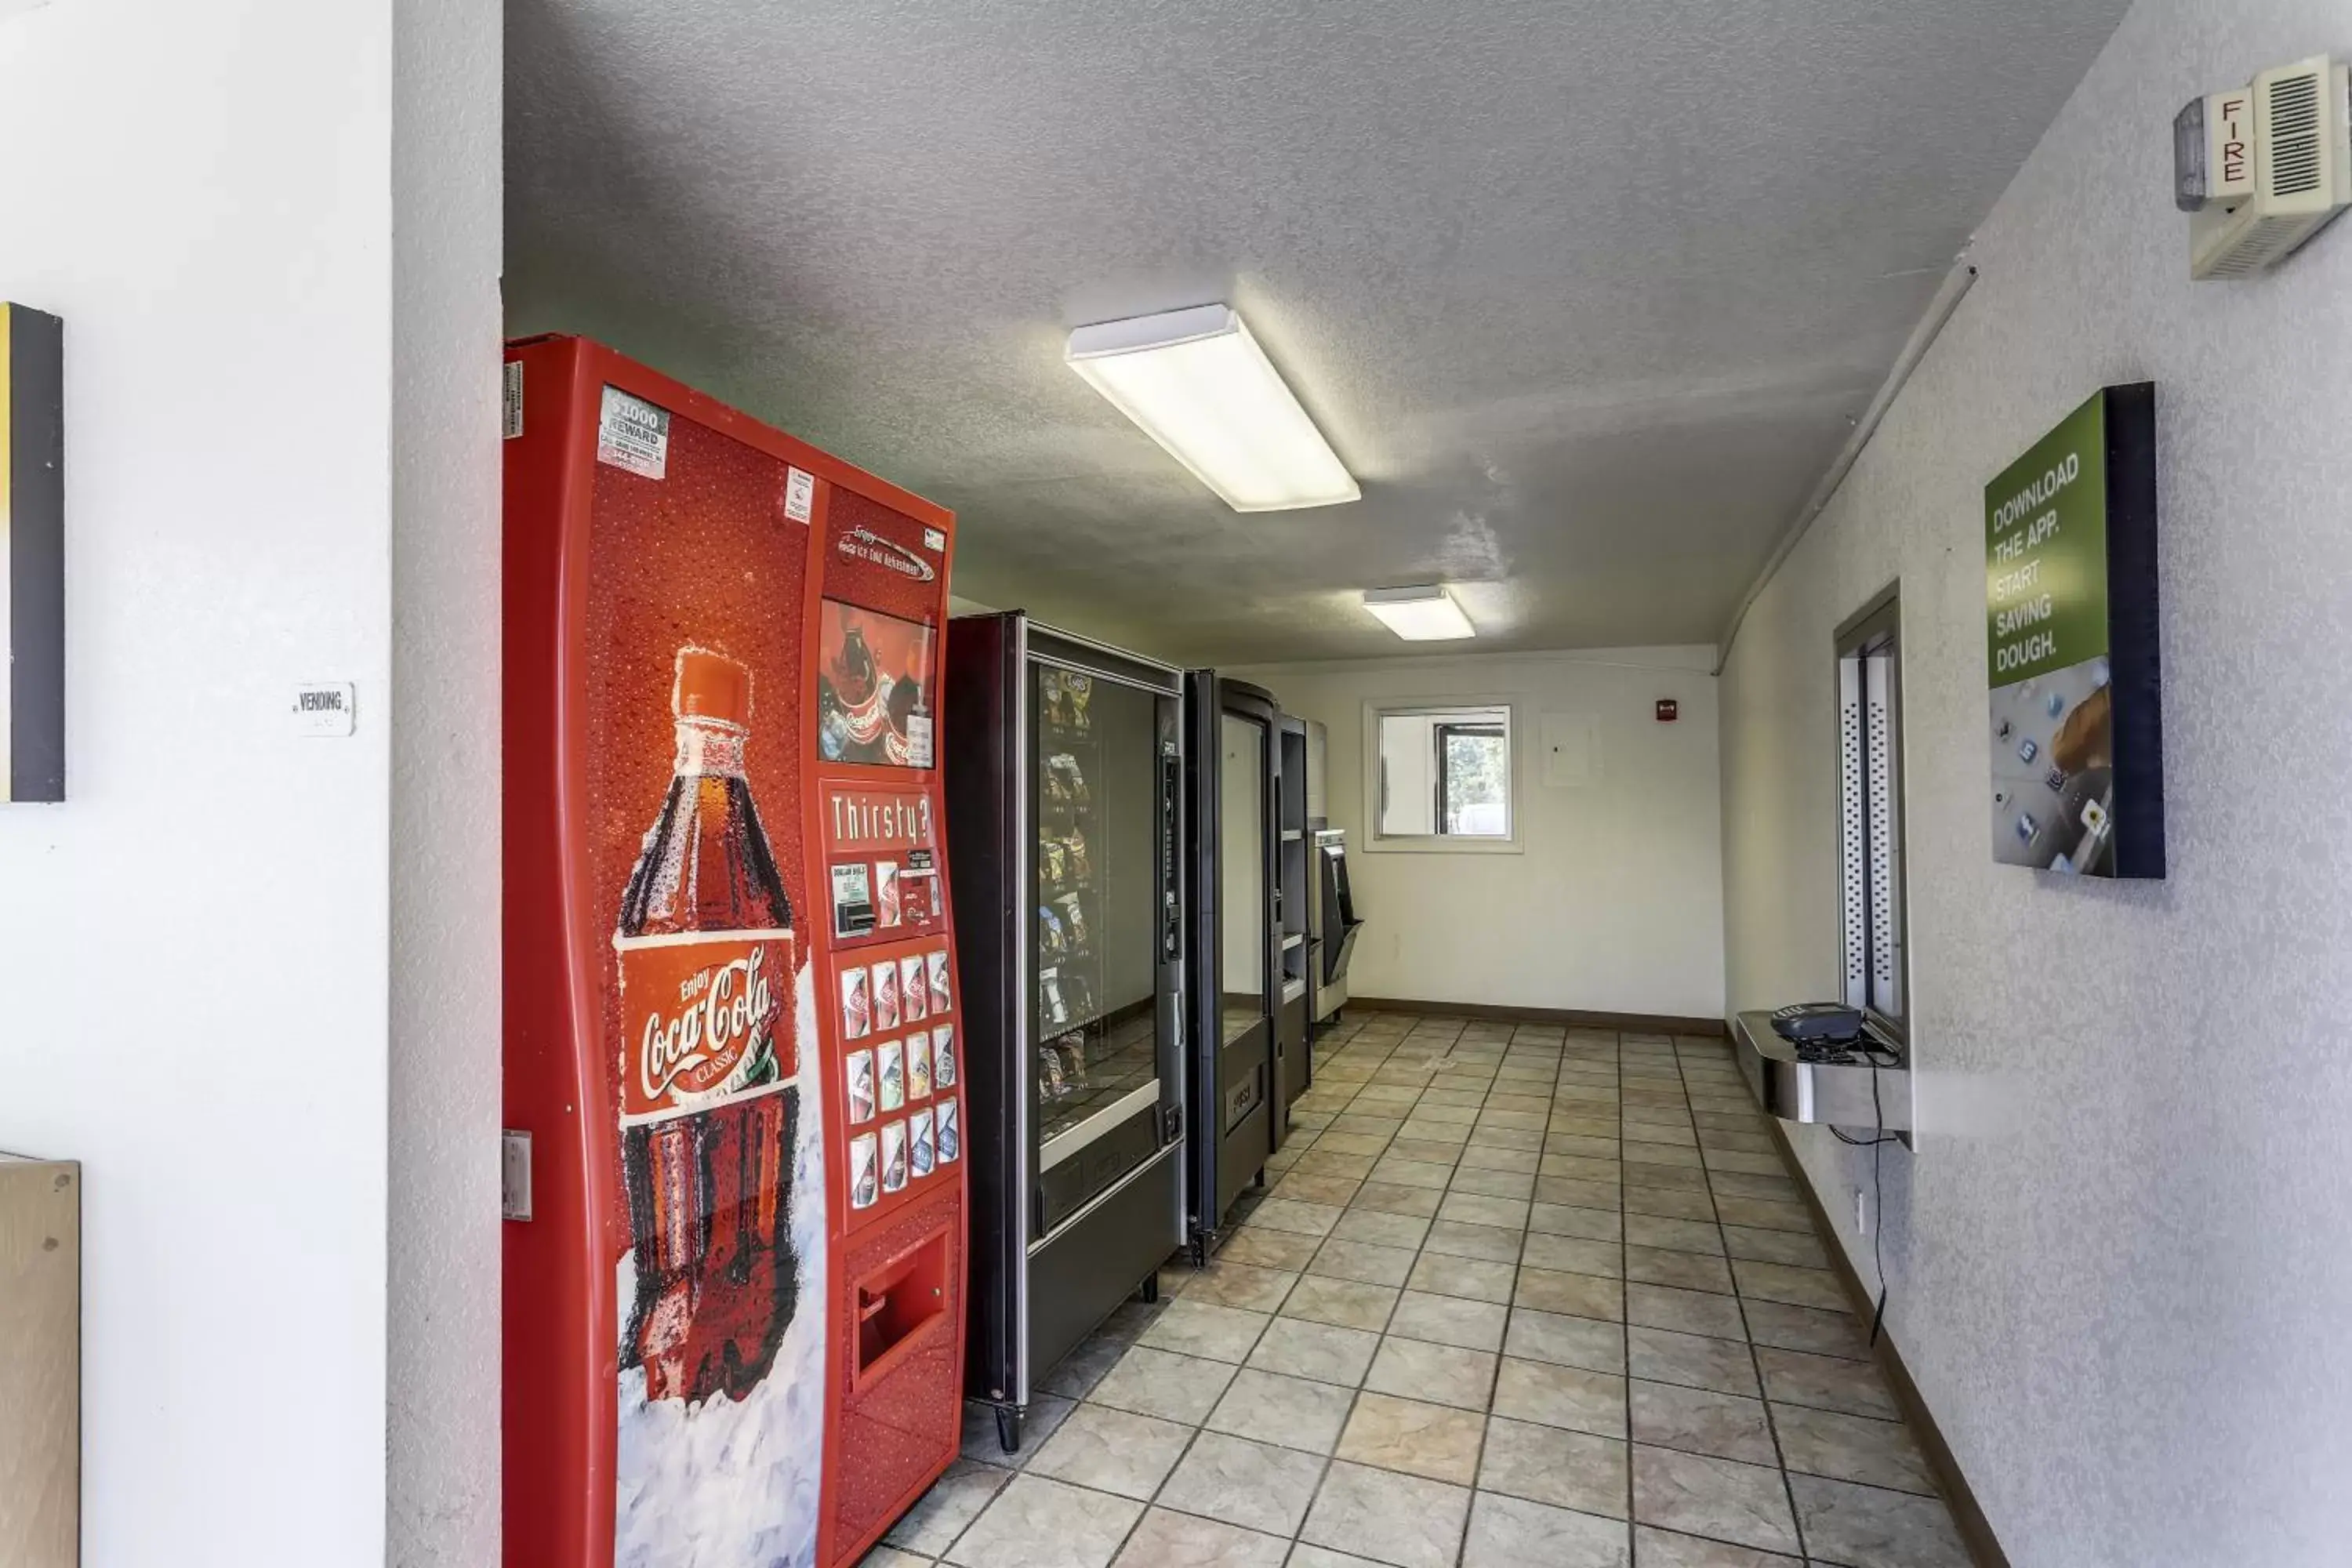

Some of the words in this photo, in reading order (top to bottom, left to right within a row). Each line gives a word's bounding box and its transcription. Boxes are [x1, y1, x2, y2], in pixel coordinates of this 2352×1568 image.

[2223, 99, 2245, 183] FIRE
[609, 418, 659, 445] REWARD
[1994, 452, 2079, 533] DOWNLOAD
[1994, 530, 2024, 566] THE
[2027, 508, 2060, 549] APP.
[1996, 559, 2041, 601] START
[1996, 593, 2052, 638] SAVING
[1997, 630, 2056, 672] DOUGH.
[299, 691, 341, 711] VENDING
[832, 796, 928, 844] Thirsty?
[681, 967, 710, 1002] Enjoy
[641, 943, 770, 1100] Coca-Cola
[695, 1046, 739, 1083] CLASSIC
